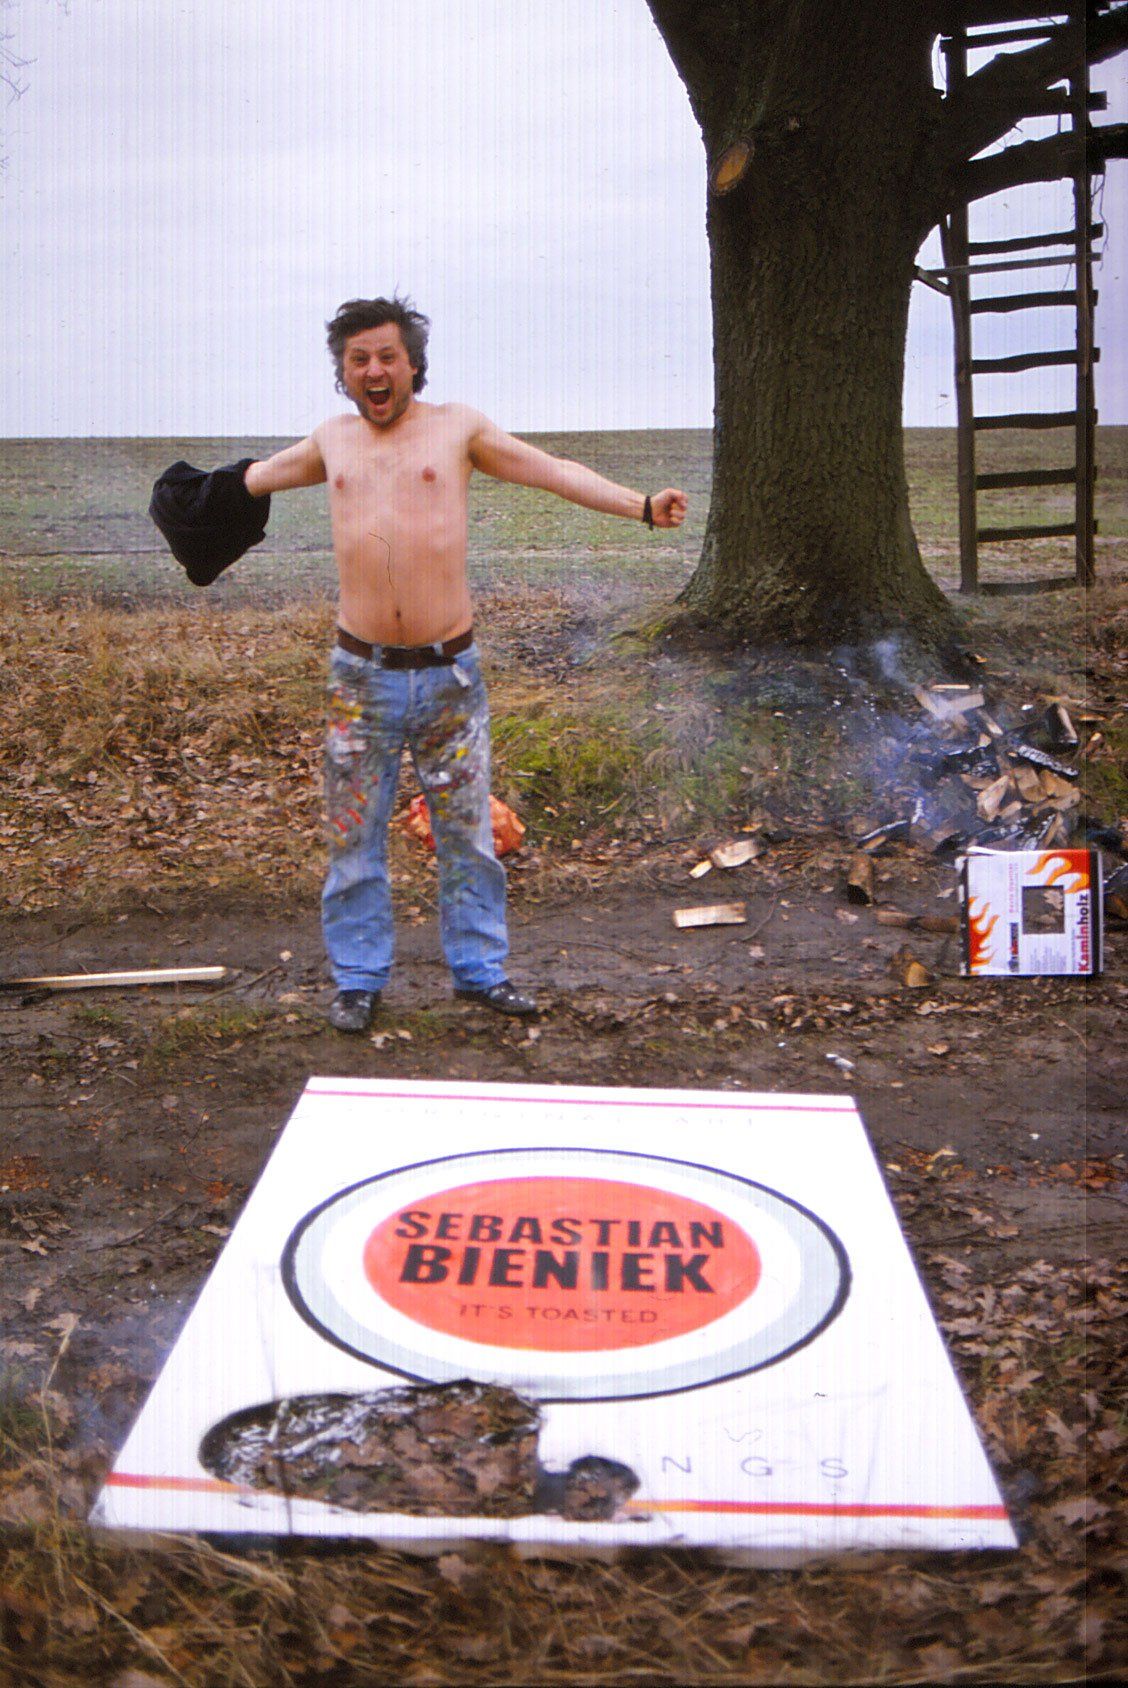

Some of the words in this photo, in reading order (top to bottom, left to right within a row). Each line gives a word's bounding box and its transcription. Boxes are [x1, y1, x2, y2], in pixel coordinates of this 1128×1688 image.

[1076, 894, 1089, 972] Kaminholz
[394, 1210, 726, 1249] SEBASTIAN
[398, 1243, 716, 1294] BIENIEK
[458, 1304, 514, 1321] IT'S
[526, 1305, 659, 1324] TOASTED
